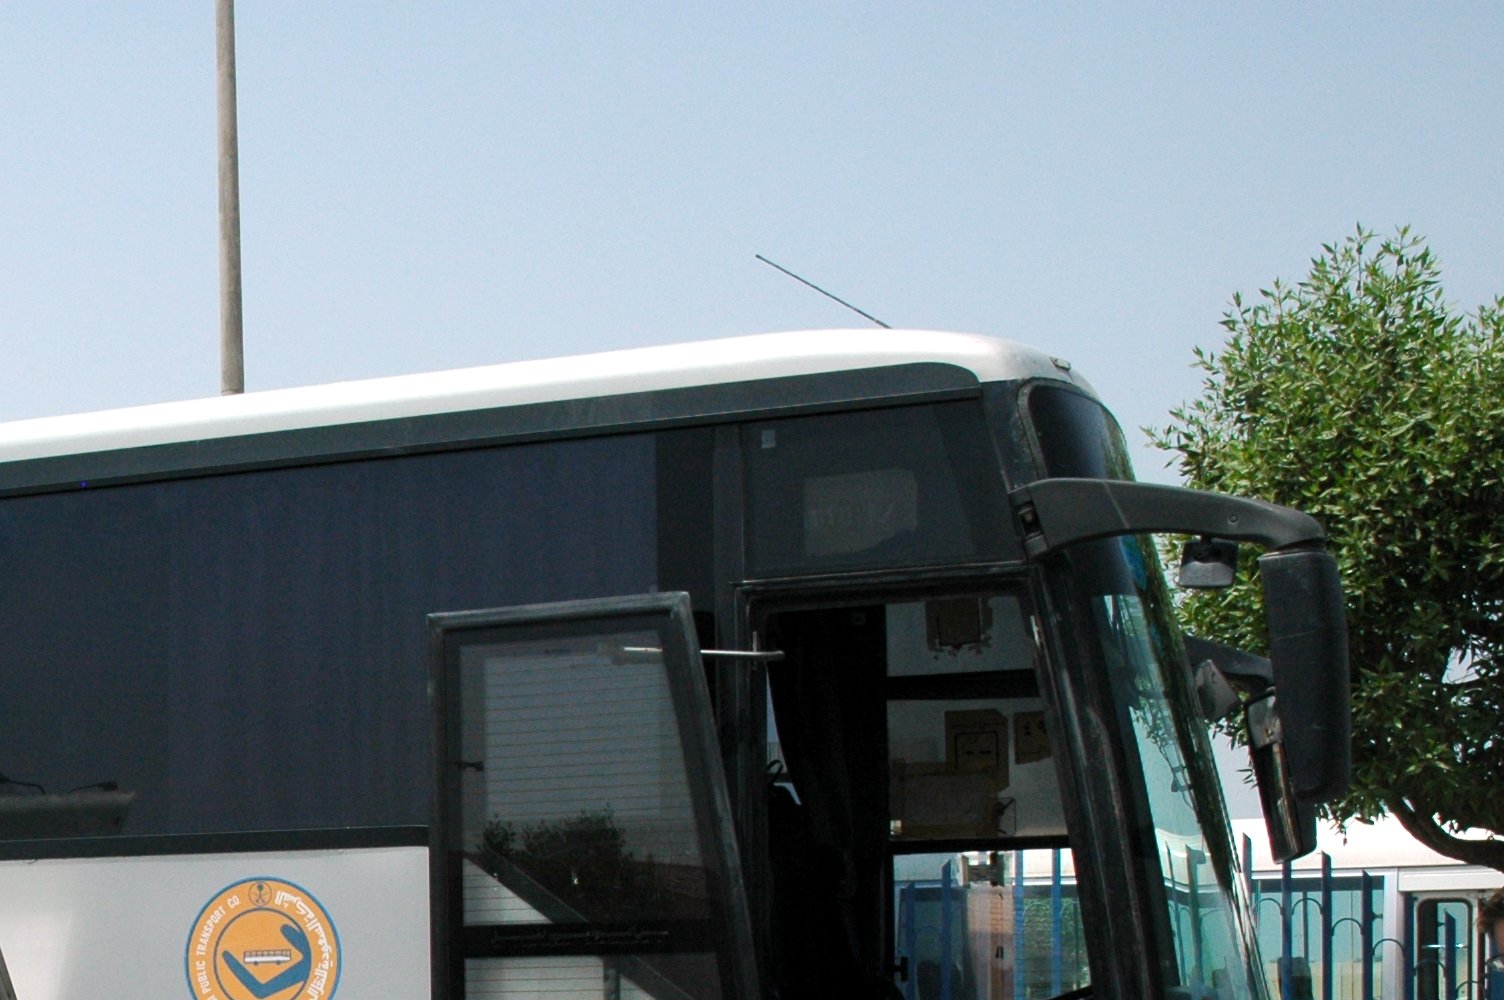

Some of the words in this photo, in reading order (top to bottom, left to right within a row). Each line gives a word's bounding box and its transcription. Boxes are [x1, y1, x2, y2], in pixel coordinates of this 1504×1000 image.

[227, 895, 240, 908] CO
[196, 905, 226, 956] TRANSPORT
[196, 960, 211, 995] PUBLIC
